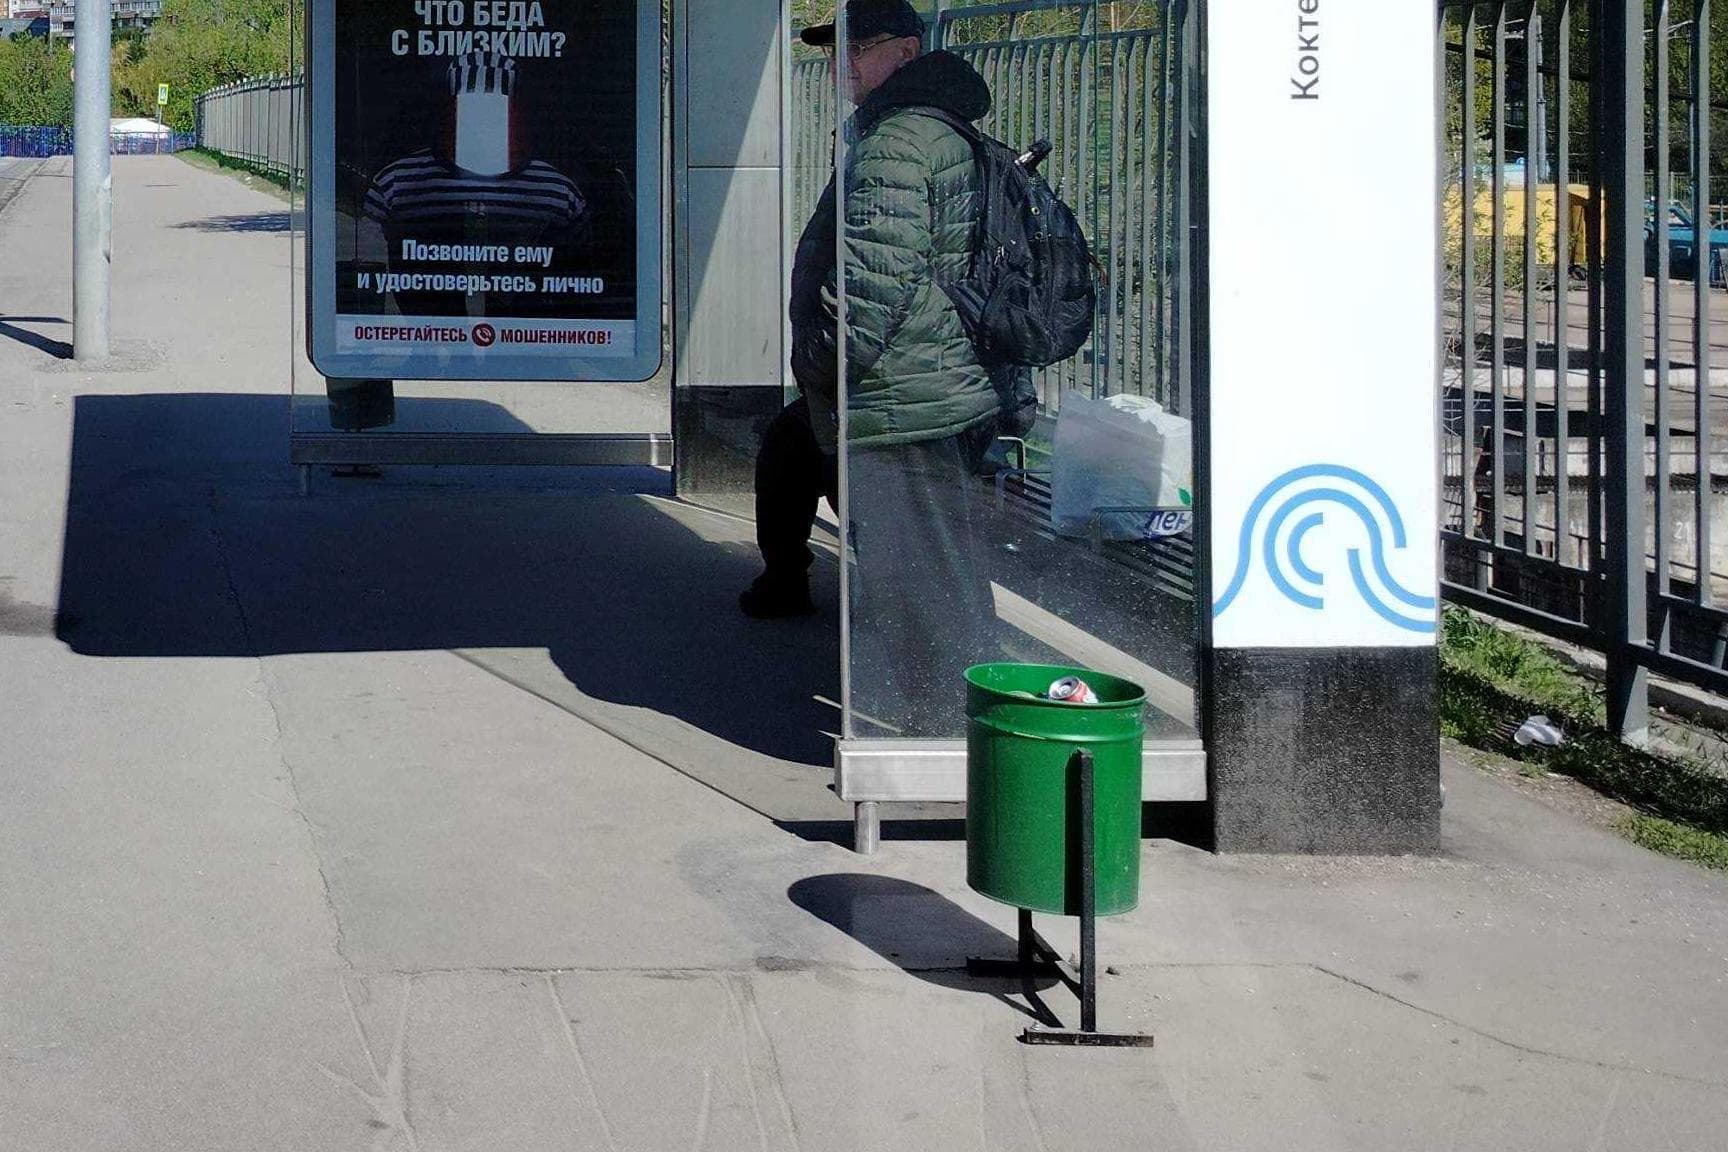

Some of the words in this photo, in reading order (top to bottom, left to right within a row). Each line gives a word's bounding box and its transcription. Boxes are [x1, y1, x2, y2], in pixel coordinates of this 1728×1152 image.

[414, 0, 465, 26] ЧТО
[473, 1, 545, 31] БЕДА
[391, 29, 409, 56] С
[418, 30, 567, 58] БЛИЗКИМ?
[402, 239, 509, 263] Позвоните
[514, 245, 553, 268] ему
[357, 272, 370, 289] и
[375, 272, 536, 296] удостоверьтесь
[540, 276, 604, 294] лично
[354, 325, 468, 342] ОСТЕРЕГАЙТЕСЬ
[500, 329, 612, 346] МОШЕННИКОВ!
